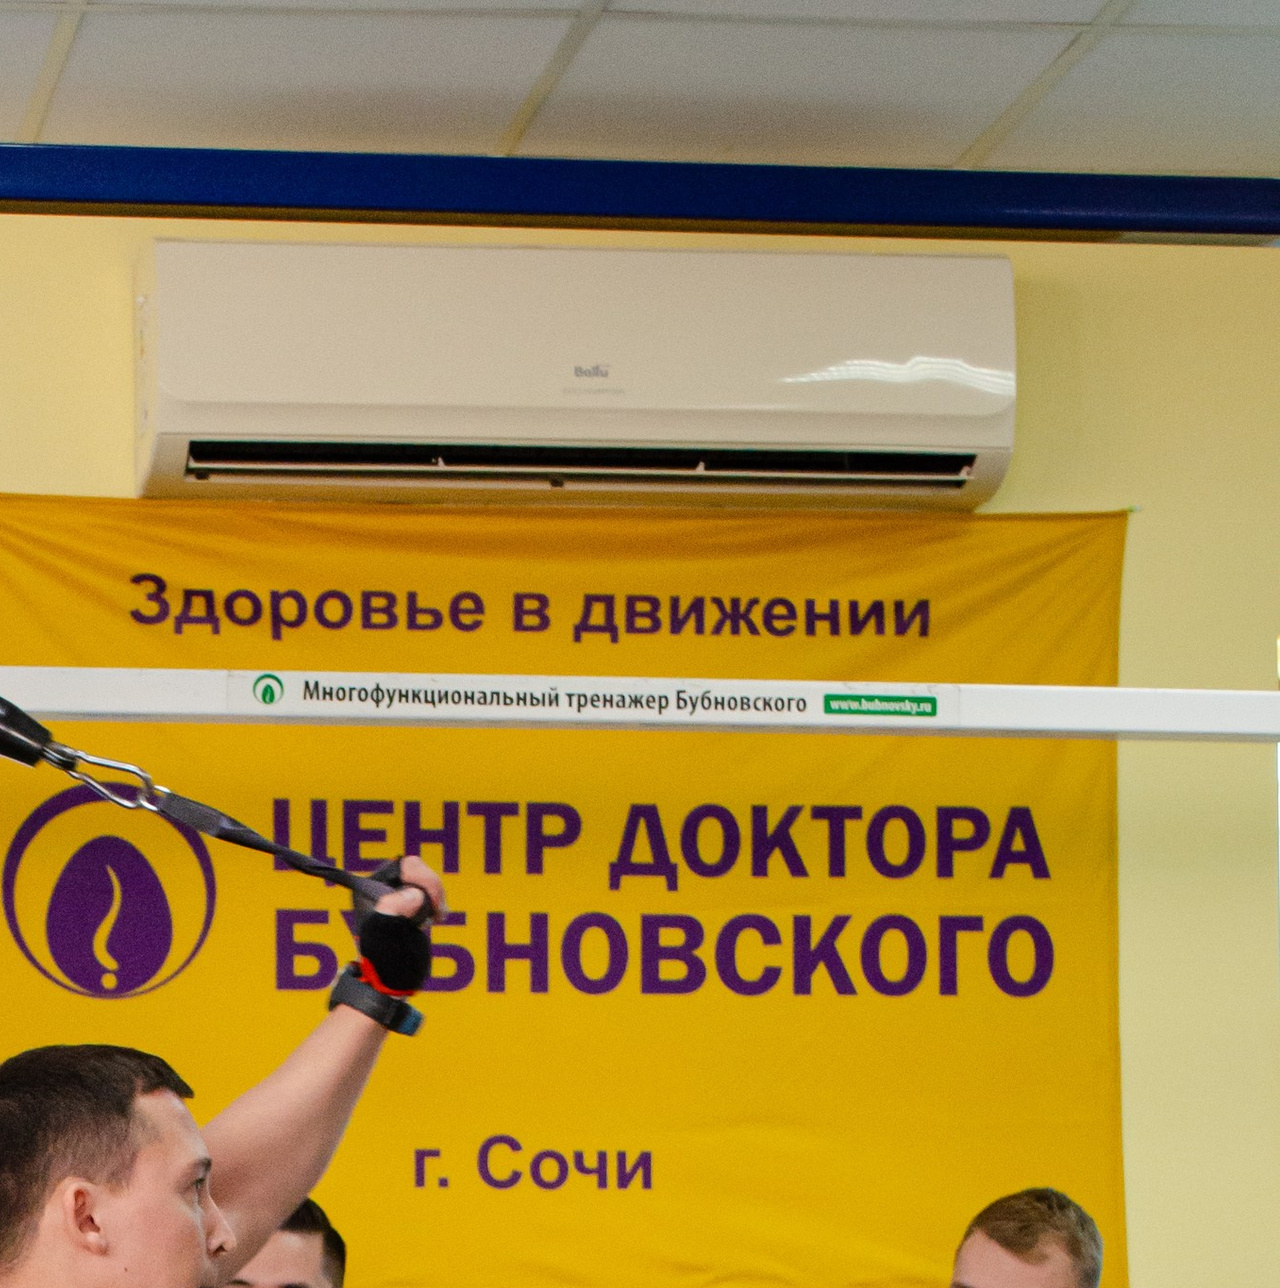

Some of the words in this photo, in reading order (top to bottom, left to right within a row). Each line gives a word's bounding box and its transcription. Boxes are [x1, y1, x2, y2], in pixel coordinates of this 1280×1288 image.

[129, 572, 486, 641] Здоровье
[512, 592, 551, 632] в
[573, 593, 930, 643] движении
[303, 680, 559, 708] Многофункциональный
[566, 691, 669, 714] тренажер
[676, 690, 807, 715] Бубновского
[272, 798, 582, 887] ЦЕНТР
[609, 803, 1052, 892] ДОКТОРА
[274, 908, 1055, 998] ББНОВСКОГО
[414, 1148, 449, 1188] г.
[477, 1134, 653, 1190] Сочи
